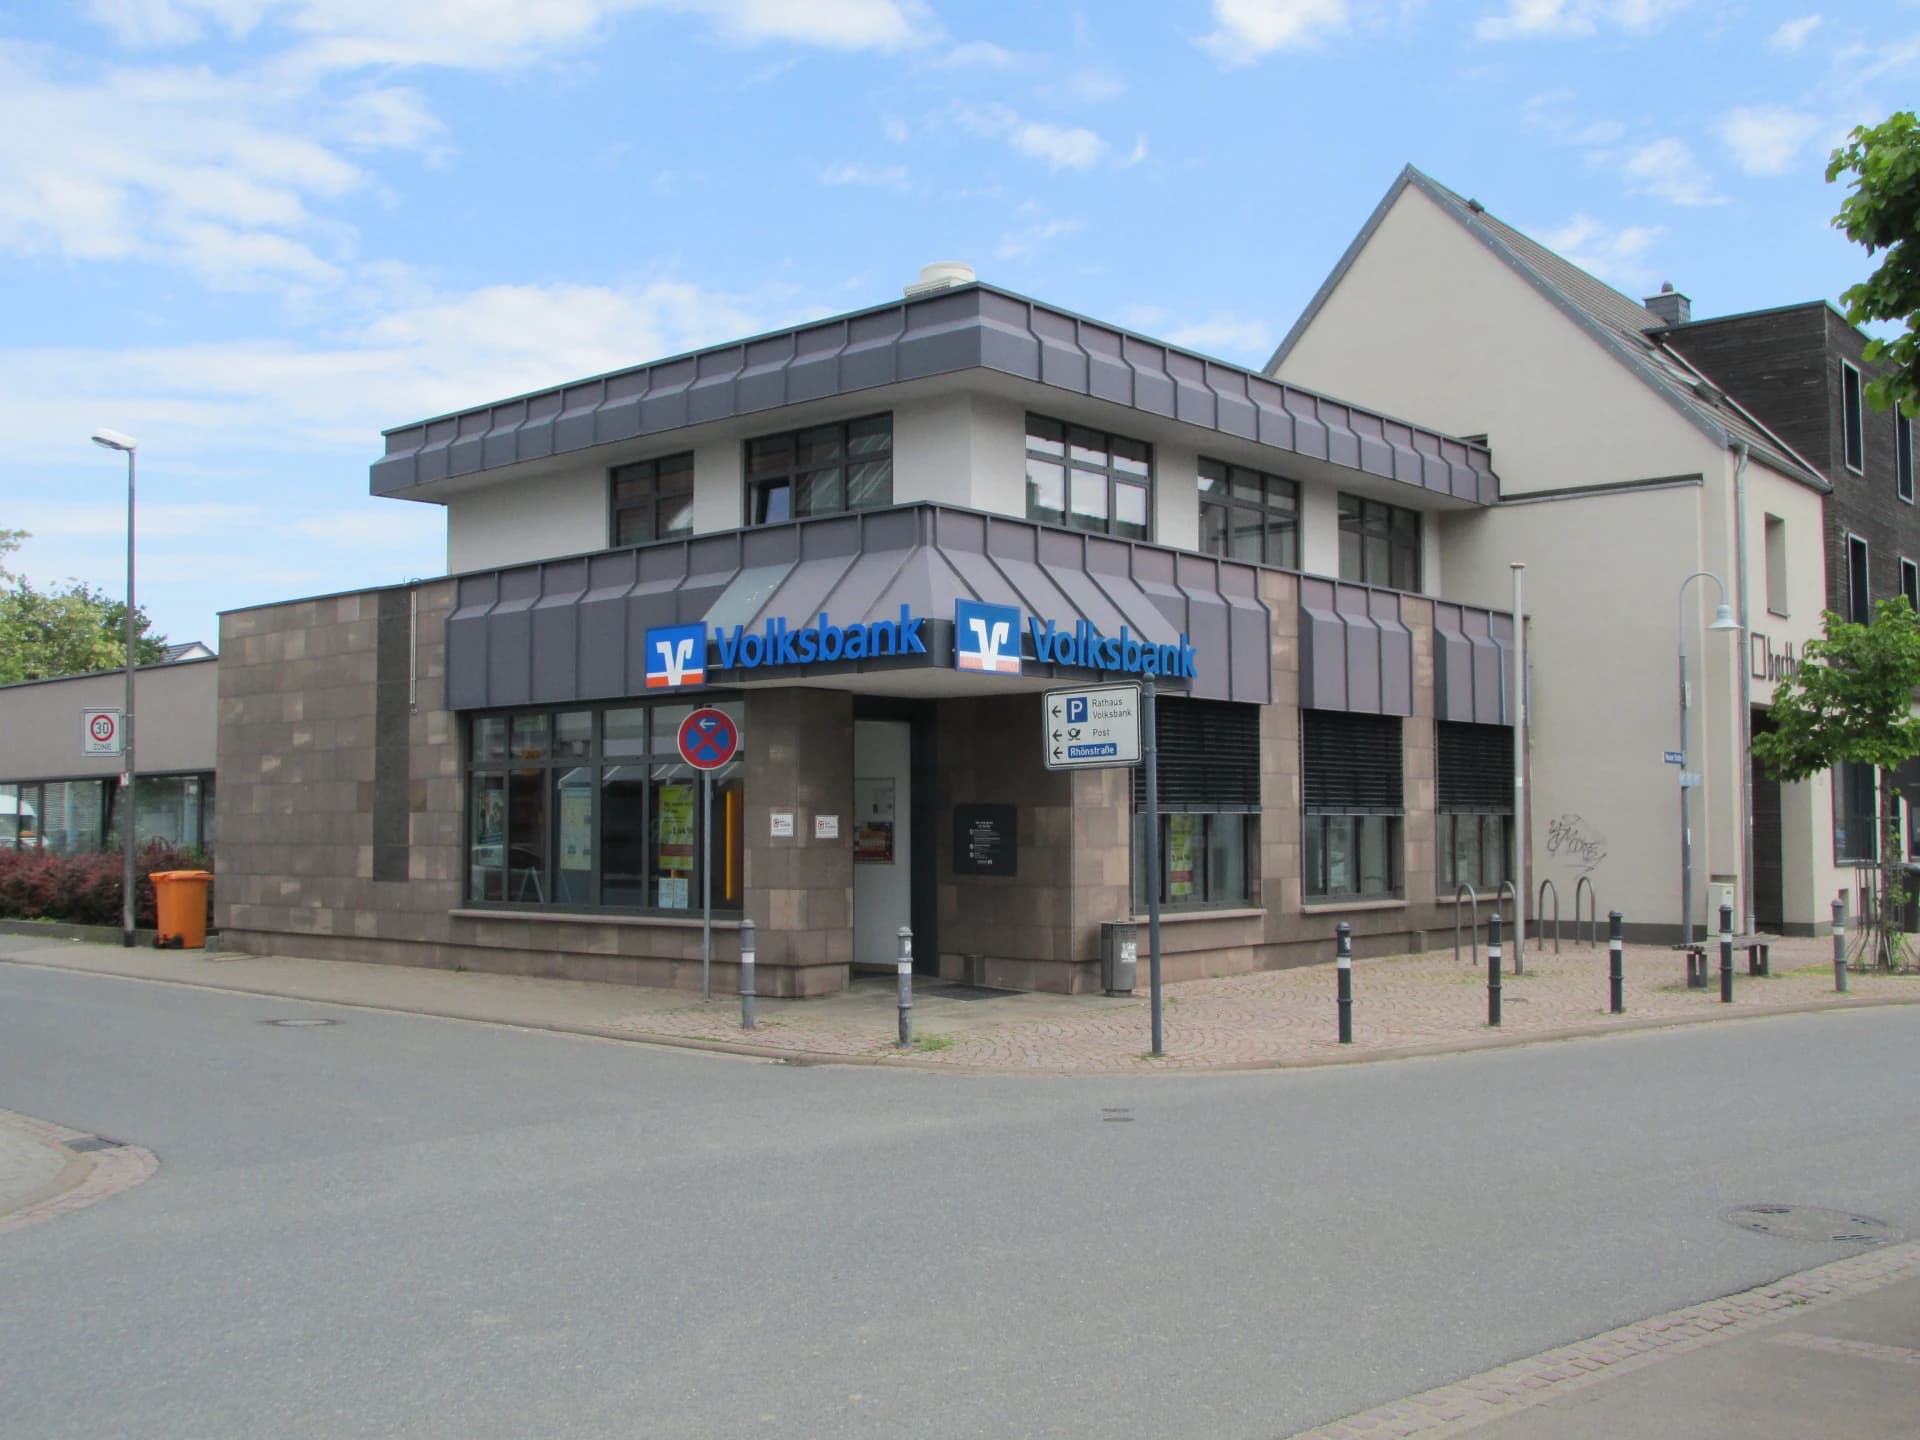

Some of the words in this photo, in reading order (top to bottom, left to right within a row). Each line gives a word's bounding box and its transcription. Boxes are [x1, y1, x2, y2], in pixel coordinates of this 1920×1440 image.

[714, 604, 927, 670] Volksbank
[1028, 616, 1199, 678] Volksbank
[1092, 698, 1123, 708] Rathaus
[1070, 700, 1083, 721] P
[1092, 708, 1132, 720] Volksbank
[95, 721, 109, 735] 30
[1092, 728, 1110, 737] Post
[1070, 744, 1115, 757] Rhönstraße
